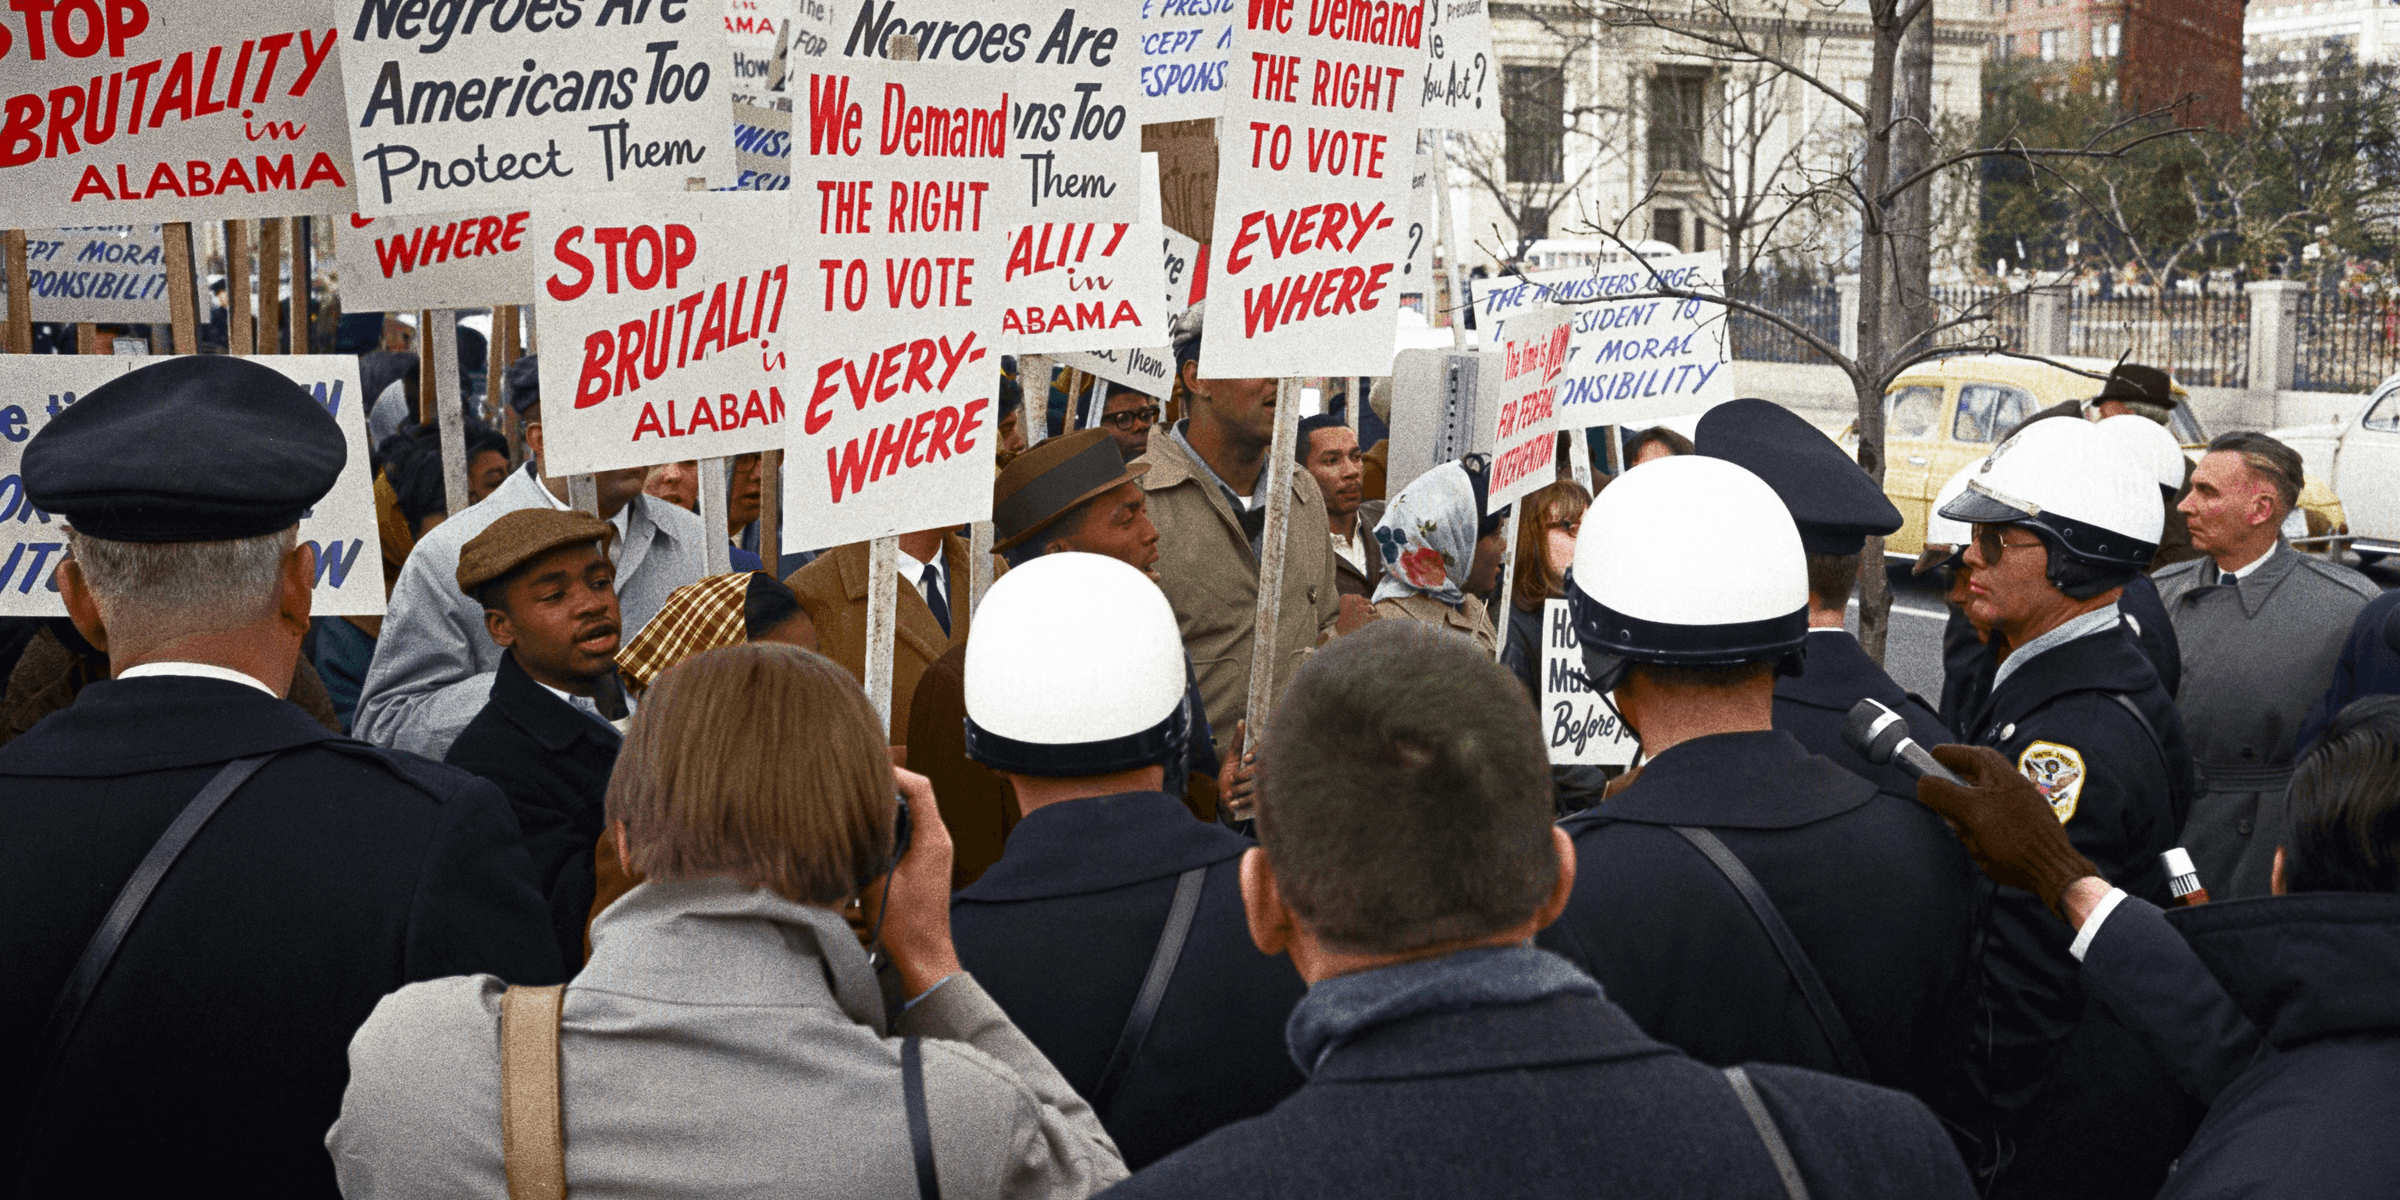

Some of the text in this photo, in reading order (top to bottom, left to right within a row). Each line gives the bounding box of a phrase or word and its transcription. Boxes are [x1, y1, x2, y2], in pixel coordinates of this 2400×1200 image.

[0, 0, 149, 60] TOP
[353, 0, 582, 53] Negroes
[1036, 8, 1118, 67] Are
[1141, 29, 1203, 55] CEPT
[1308, 0, 1424, 49] Demand
[0, 28, 338, 168] BRUTALITY
[360, 40, 711, 127] Americans Too
[1252, 51, 1405, 113] THE RIGHT
[242, 109, 307, 141] in
[810, 73, 1009, 159] We Demand
[1013, 82, 1126, 142] ns Too
[71, 152, 346, 202] ALABAMA
[363, 118, 707, 204] Protect Them
[1020, 149, 1117, 208] Them
[1250, 121, 1388, 179] TO VOTE
[817, 181, 989, 235] THE RIGHT
[77, 241, 167, 265] MORA
[375, 212, 530, 278] WHERE
[546, 224, 697, 302] STOP
[1226, 200, 1395, 276] EVERY-
[819, 257, 975, 311] TO VOTE
[1067, 268, 1113, 292] in
[1244, 262, 1394, 339] WHERE
[1486, 280, 1528, 316] THE
[1595, 336, 1692, 364] MORAL
[804, 331, 987, 435] EVERY-
[827, 397, 990, 504] WHERE
[1551, 701, 1616, 756] Before
